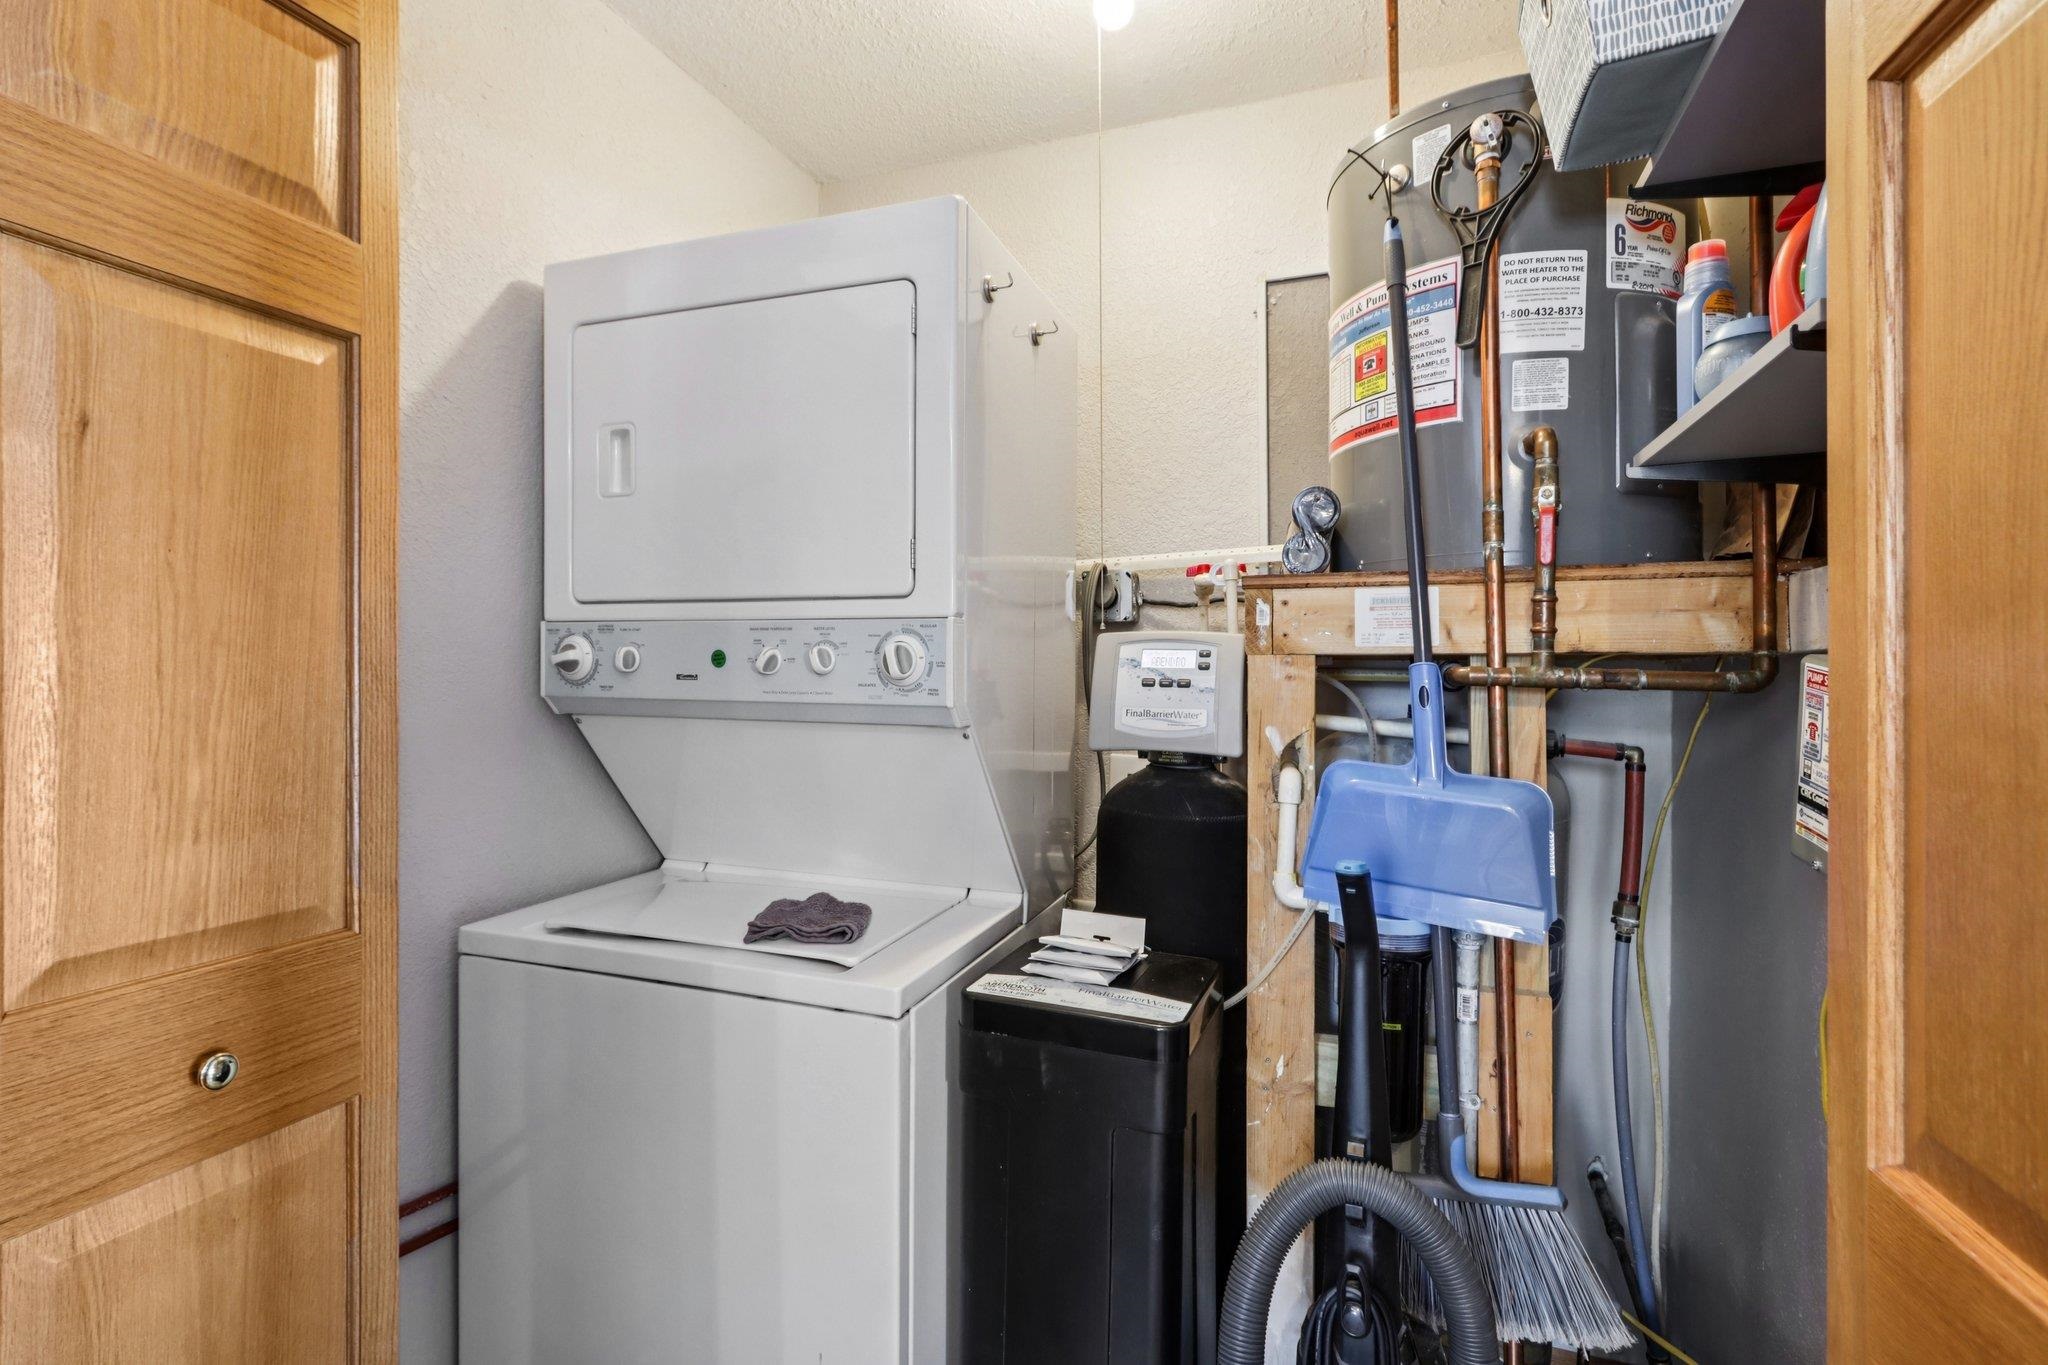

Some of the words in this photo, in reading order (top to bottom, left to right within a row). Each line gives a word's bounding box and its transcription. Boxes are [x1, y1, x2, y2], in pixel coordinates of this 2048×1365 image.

[1625, 203, 1673, 223] Richmond
[1614, 223, 1627, 256] 6
[1535, 256, 1566, 264] RETURN
[1501, 268, 1528, 276] WATER
[1529, 266, 1558, 274] HEATER
[1505, 277, 1528, 286] PLACE
[1542, 275, 1581, 283] PURCHASE
[1340, 306, 1354, 323] Well
[1355, 303, 1364, 314] &
[1366, 293, 1388, 309] Pum
[1405, 272, 1449, 292] ystems
[1500, 306, 1584, 319] 1-800-432-8373
[1407, 316, 1430, 327] UMPS
[1408, 328, 1430, 339] ANKS
[1416, 358, 1450, 370] SAMPLES
[1354, 419, 1394, 438] aquawell.net
[1807, 670, 1824, 686] PUMP
[1125, 708, 1199, 720] FinalBarrierWater
[1078, 987, 1183, 1011] FinalBarrierWater
